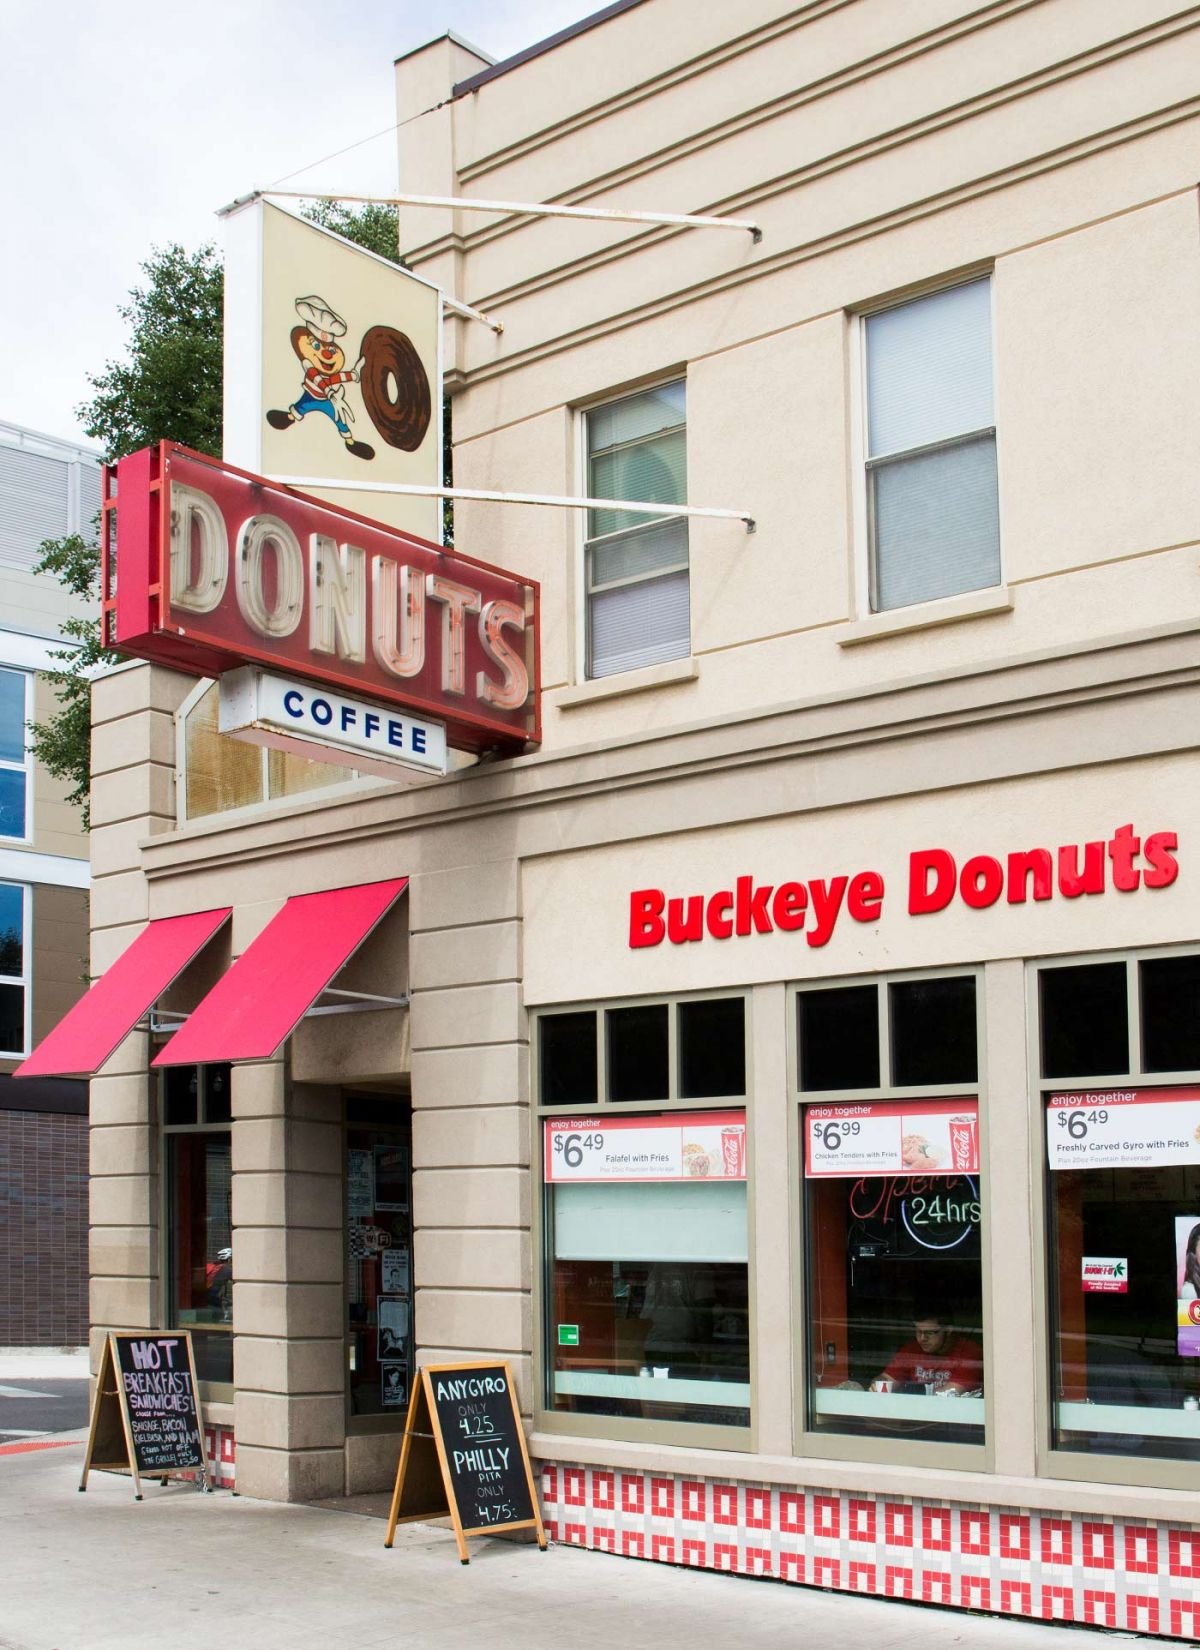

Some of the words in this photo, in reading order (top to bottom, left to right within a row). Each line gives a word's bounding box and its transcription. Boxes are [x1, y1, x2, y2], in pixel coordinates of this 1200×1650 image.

[170, 480, 529, 711] DONUTS
[283, 690, 427, 754] COFFEE
[629, 871, 885, 948] Buckeye
[908, 823, 1179, 916] Donuts
[1051, 1094, 1083, 1106] enjoy
[1085, 1091, 1137, 1105] together
[809, 1107, 833, 1117] enjoy
[834, 1105, 872, 1116] together
[550, 1120, 570, 1130] enjoy
[570, 1119, 601, 1129] together
[1056, 1143, 1087, 1152] Freshly
[1089, 1142, 1120, 1151] Carved
[1122, 1142, 1144, 1151] Gyro
[1146, 1140, 1165, 1149] with
[1167, 1139, 1190, 1148] Fries
[605, 1154, 631, 1163] Falafel
[632, 1154, 649, 1162] with
[650, 1153, 670, 1162] Fries
[1120, 1154, 1153, 1163] Beverage
[911, 1194, 981, 1225] 24hrs
[130, 1339, 179, 1370] HOT
[123, 1371, 191, 1394] BREAKFAST
[457, 1402, 488, 1417] ONLY
[161, 1416, 187, 1432] BACON
[459, 1415, 495, 1436] 4.25
[453, 1447, 510, 1475] PHILLY
[478, 1472, 502, 1484] PITA
[476, 1485, 505, 1498] ONLY
